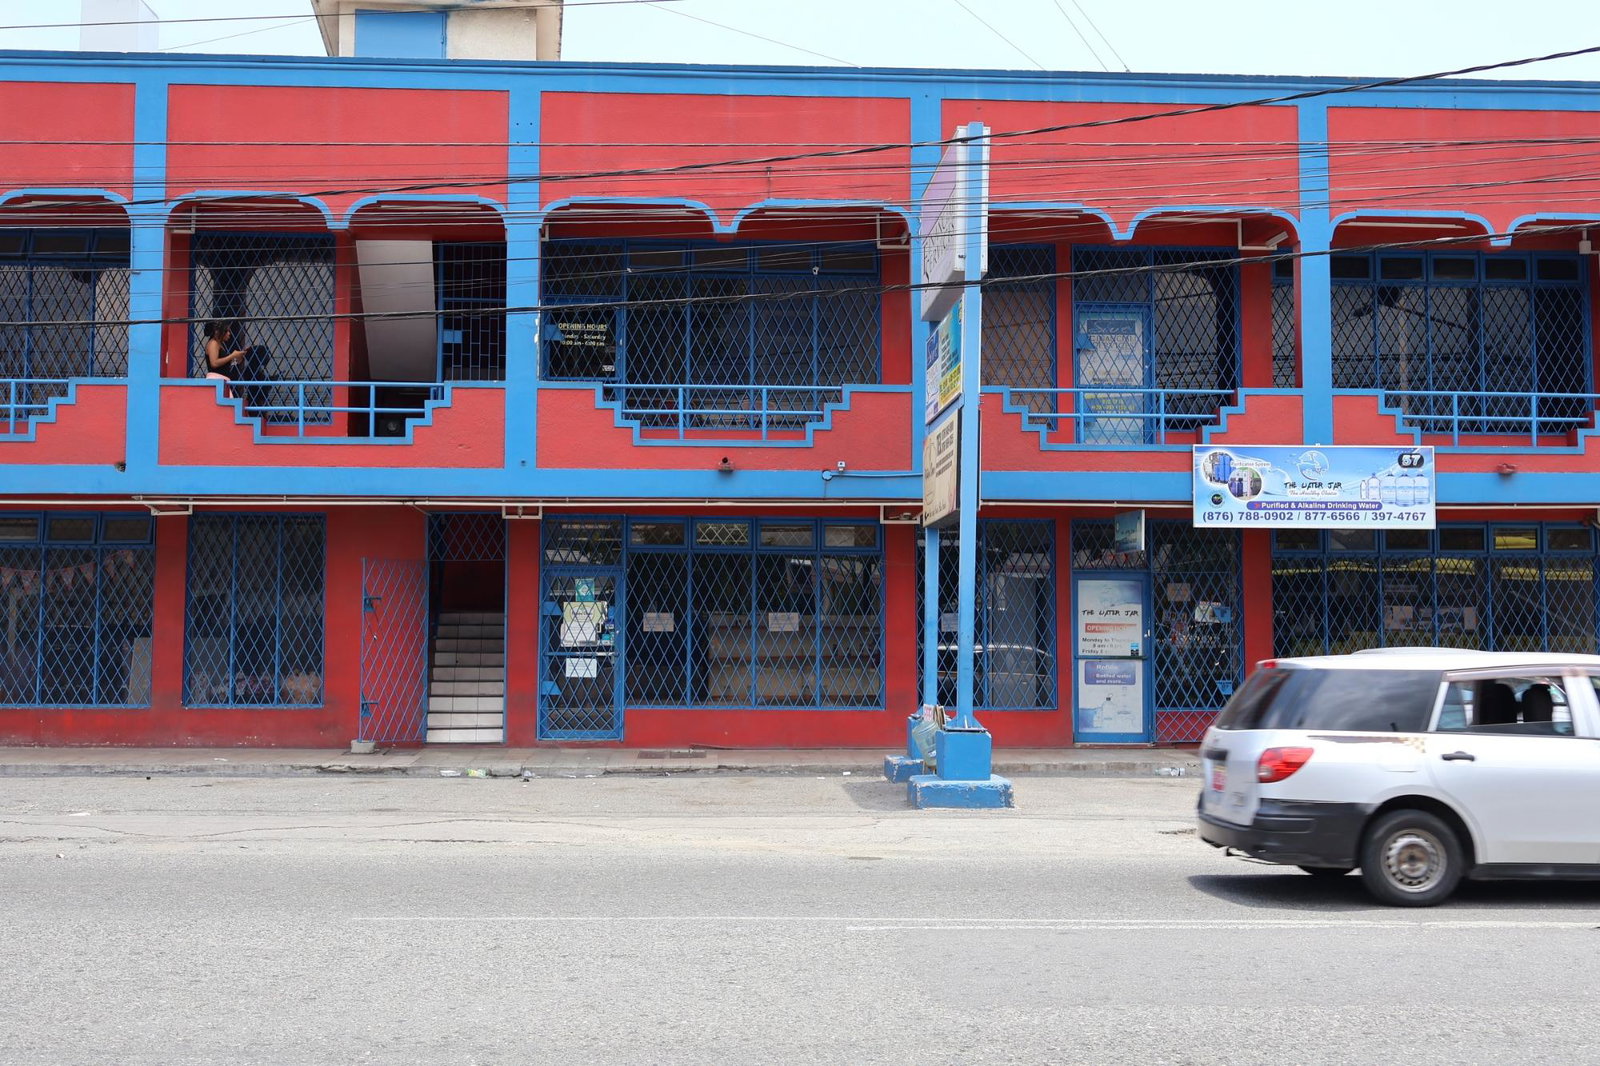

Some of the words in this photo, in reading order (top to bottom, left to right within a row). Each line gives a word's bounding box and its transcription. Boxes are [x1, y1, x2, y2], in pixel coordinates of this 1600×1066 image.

[1301, 482, 1323, 490] WATER
[1327, 482, 1342, 490] JAR
[1327, 502, 1357, 510] Drinking
[1358, 502, 1379, 510] Water
[1203, 511, 1234, 522] (876)
[1238, 511, 1294, 521] 788-0902
[1304, 512, 1360, 521] 877-6566
[1371, 512, 1426, 521] 397-4767
